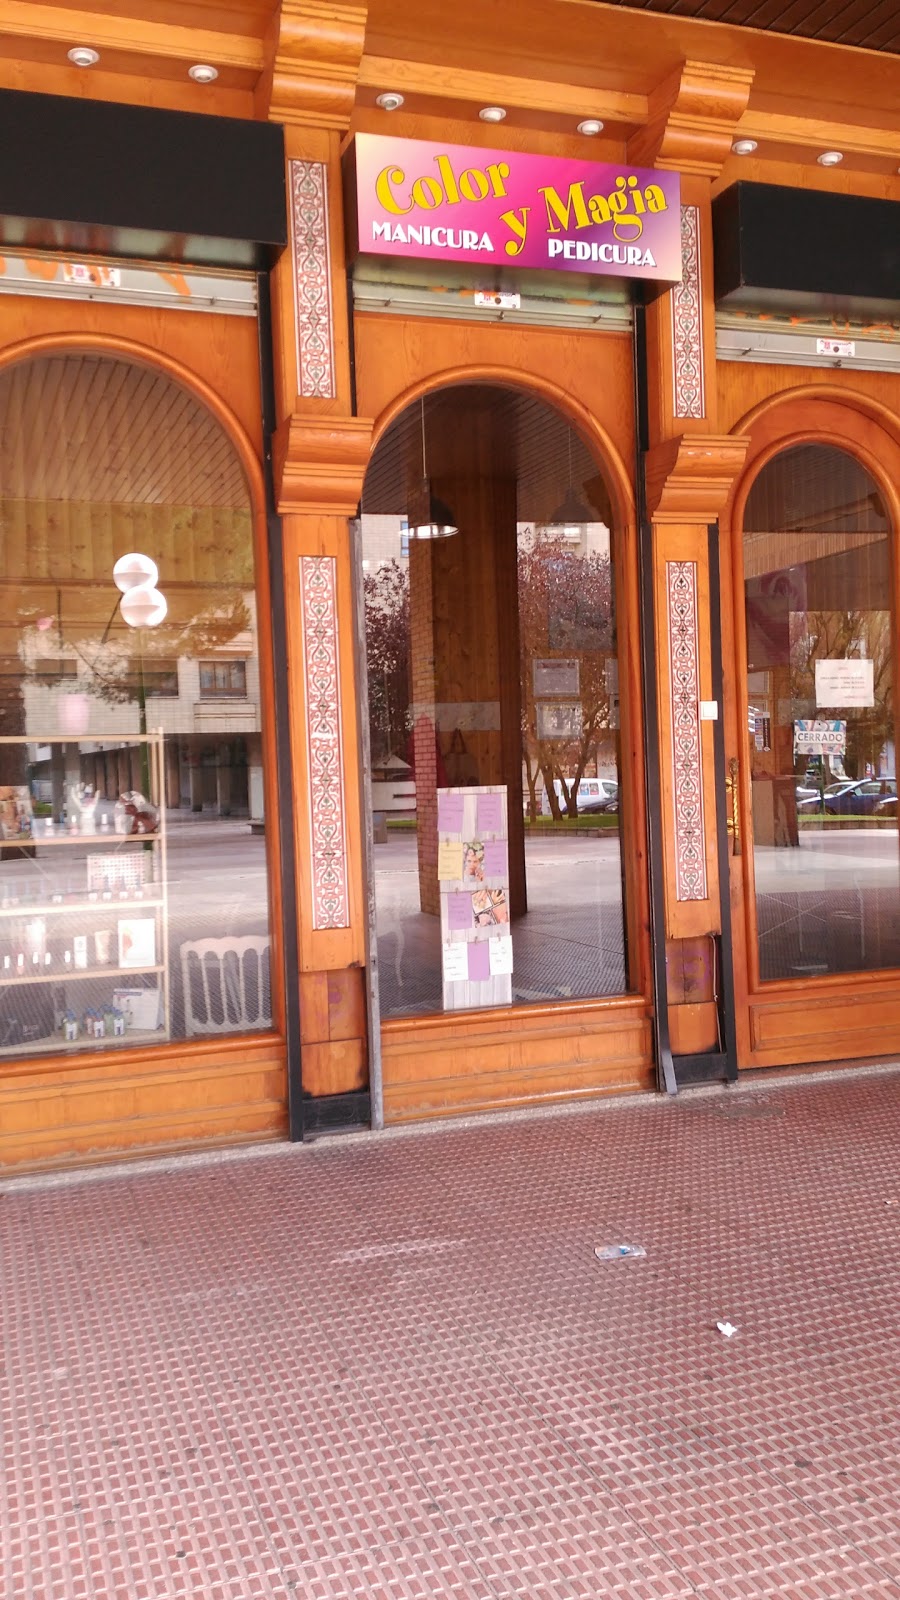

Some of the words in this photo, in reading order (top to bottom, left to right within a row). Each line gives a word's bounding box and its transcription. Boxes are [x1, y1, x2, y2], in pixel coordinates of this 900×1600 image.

[375, 154, 511, 215] Color
[500, 207, 531, 257] y
[538, 175, 668, 242] Magia
[372, 221, 495, 252] MANICURA
[548, 238, 657, 267] PEDICURA
[797, 733, 843, 742] CERRADO
